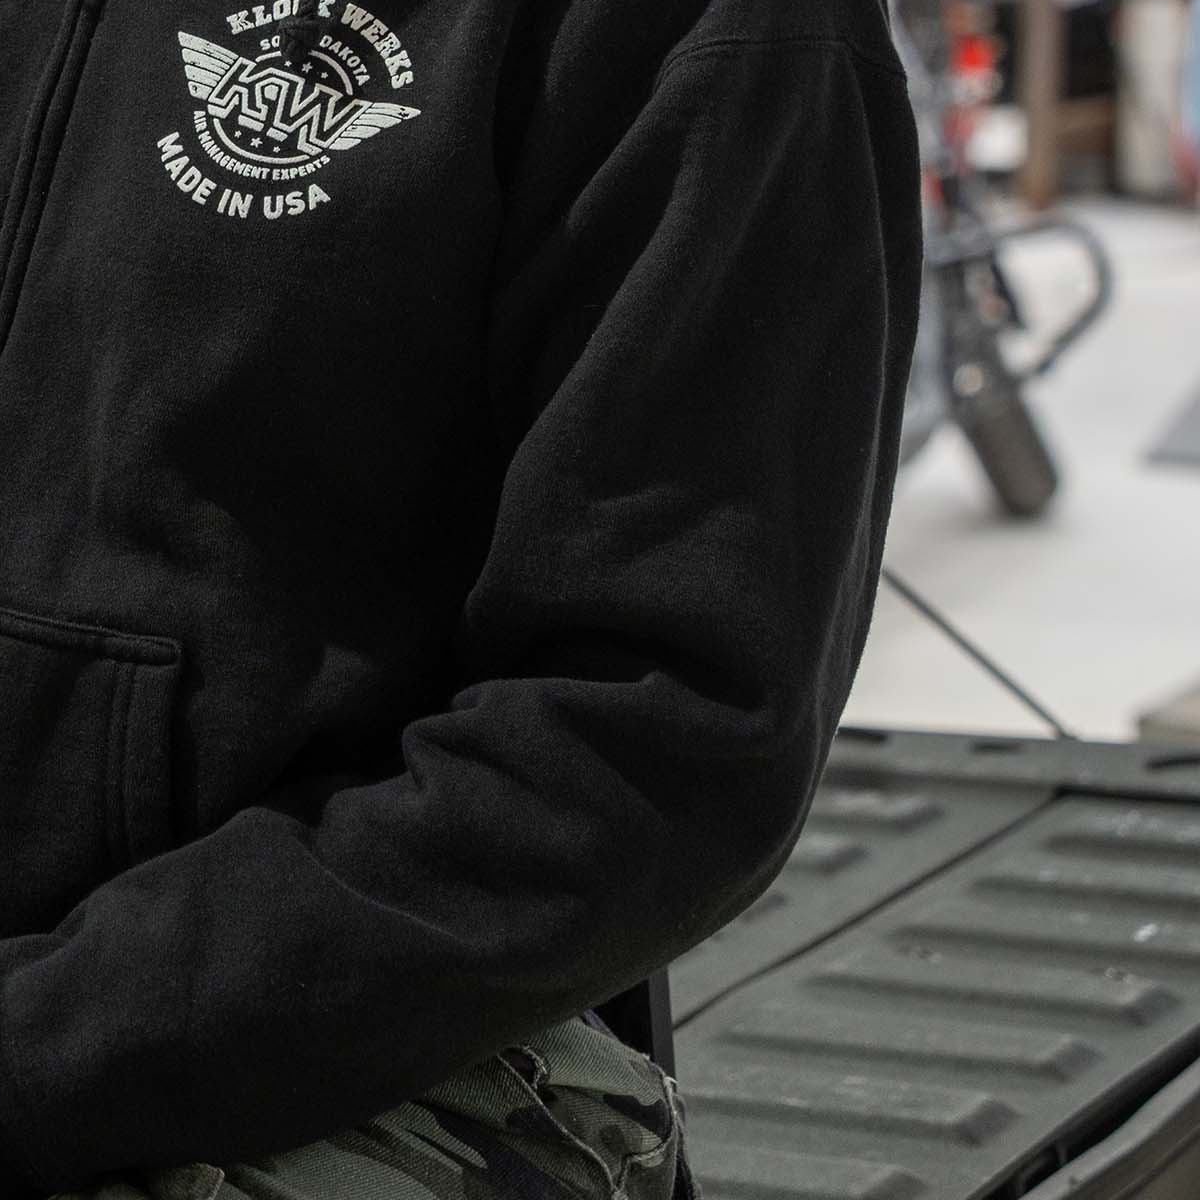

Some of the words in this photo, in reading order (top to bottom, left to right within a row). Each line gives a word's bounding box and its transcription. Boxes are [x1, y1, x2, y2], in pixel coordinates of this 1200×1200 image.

[319, 35, 370, 86] DAKOTA
[340, 2, 414, 89] WERKS
[193, 110, 207, 133] AIR
[157, 131, 217, 205] MADE
[217, 188, 253, 219] IN
[263, 183, 331, 220] USA
[198, 131, 271, 180] MANAGEMENT
[272, 155, 331, 180] EXPERTS
